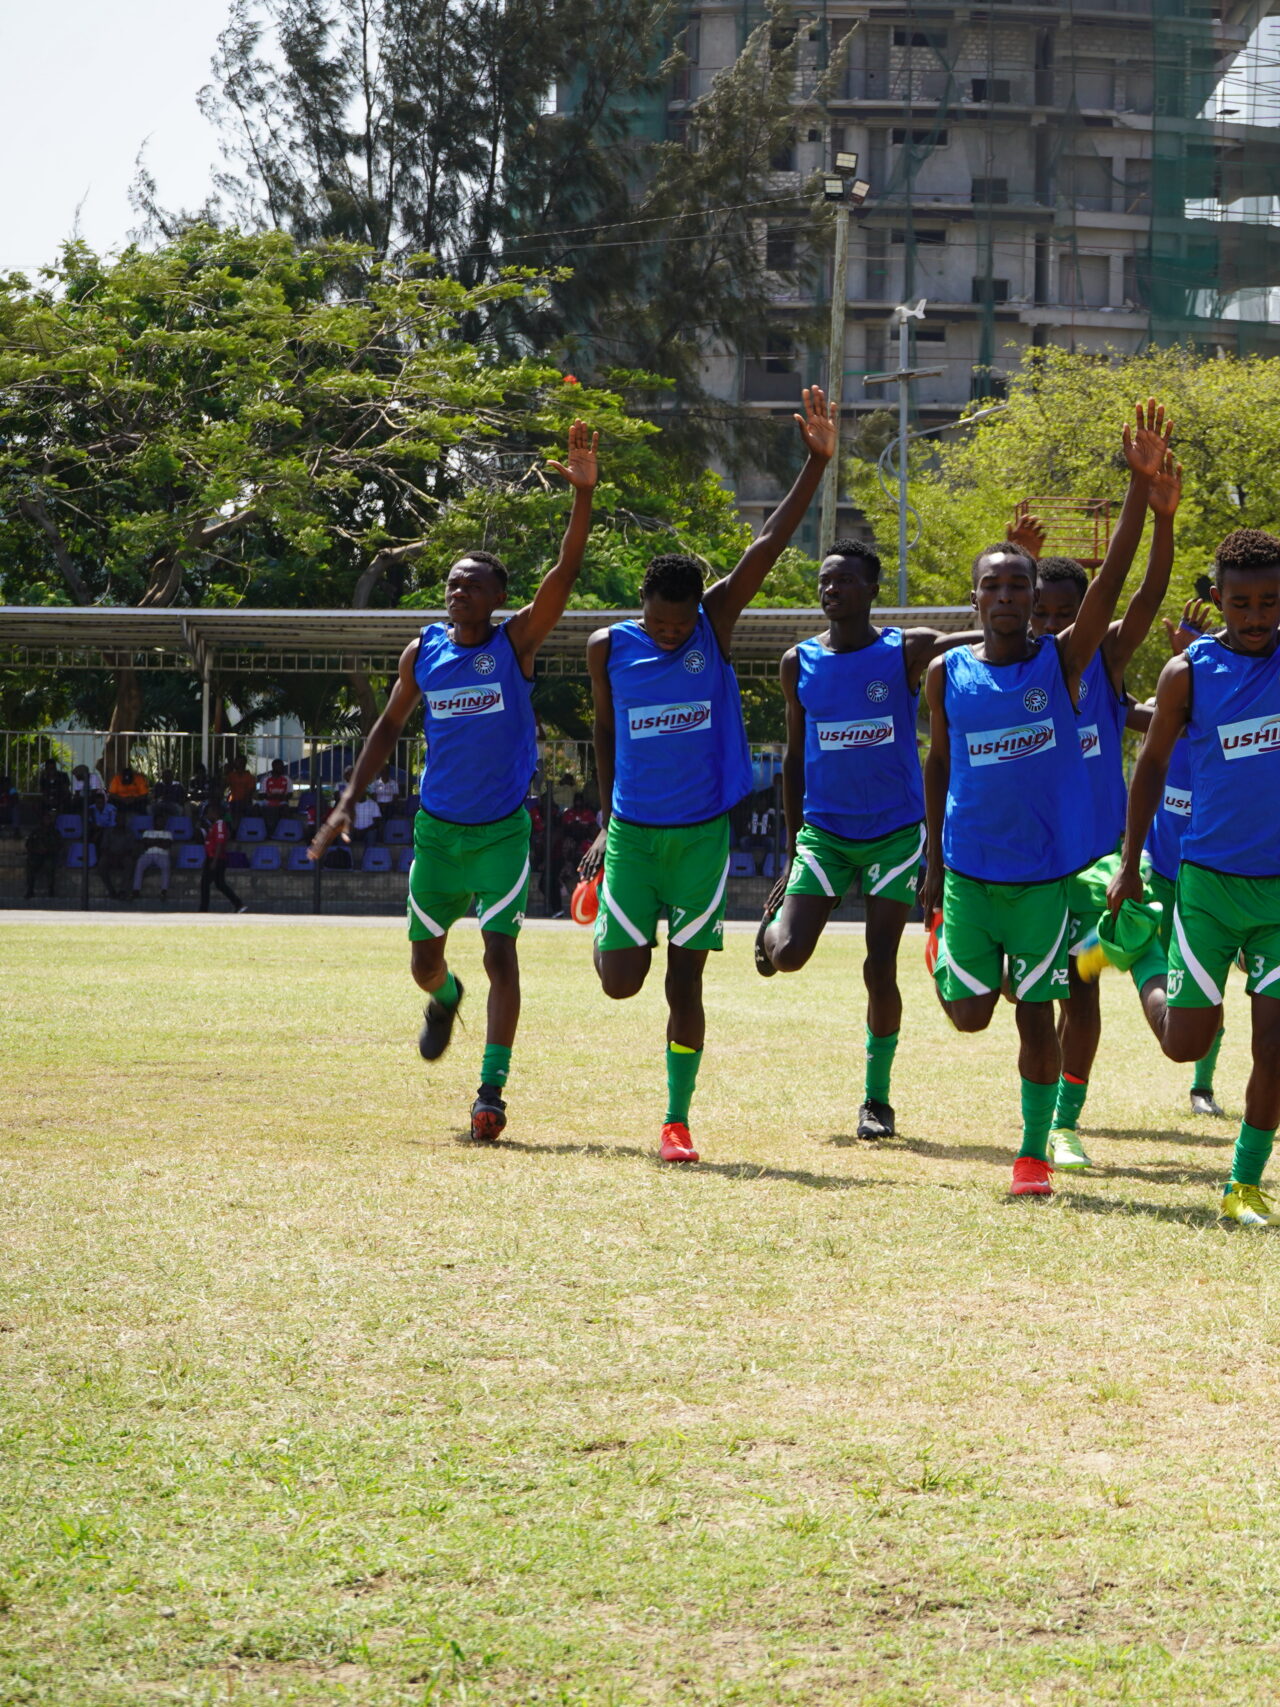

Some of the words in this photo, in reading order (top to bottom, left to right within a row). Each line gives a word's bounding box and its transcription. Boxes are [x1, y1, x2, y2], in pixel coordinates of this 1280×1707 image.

[631, 709, 710, 731] USHINDI
[820, 728, 893, 742] USHINDI
[970, 729, 1054, 756] USHINDI
[867, 863, 880, 882] 4
[1251, 955, 1265, 978] 3
